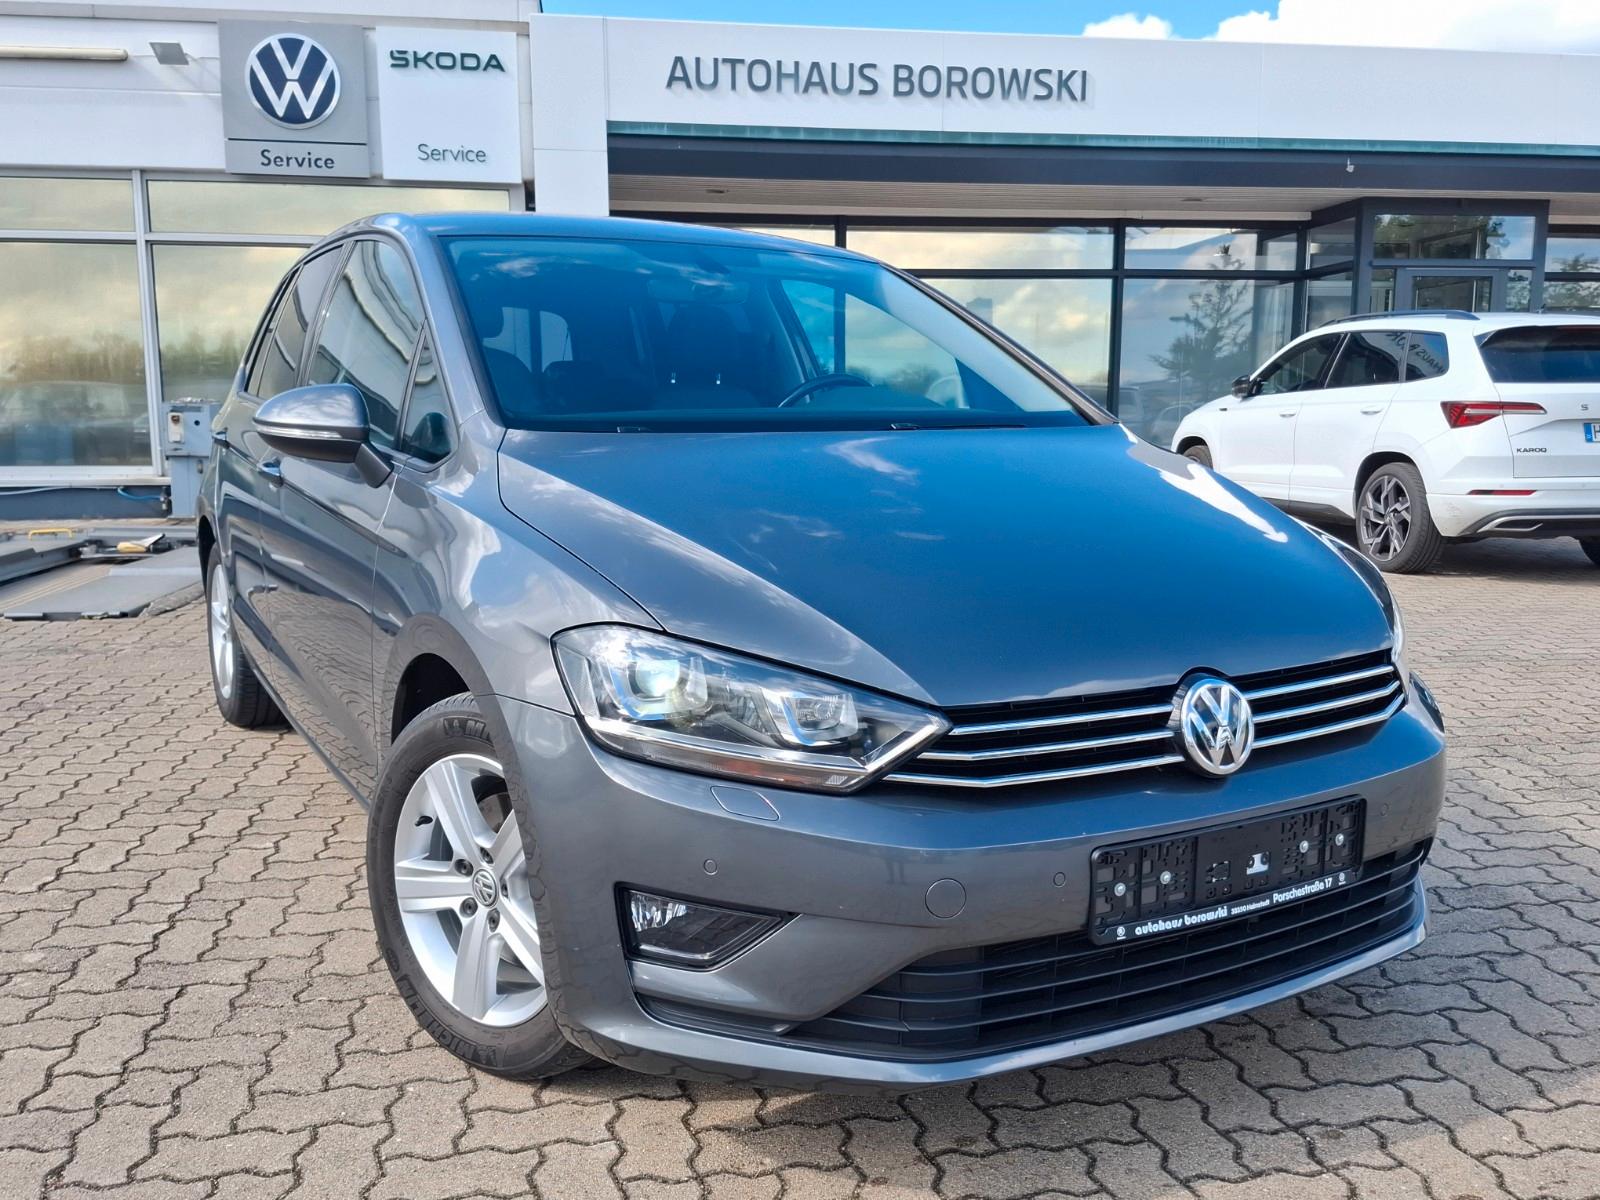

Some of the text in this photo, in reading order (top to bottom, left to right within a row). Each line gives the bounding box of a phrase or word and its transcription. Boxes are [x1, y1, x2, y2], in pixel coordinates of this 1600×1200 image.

[665, 55, 1088, 102] AUTOHAUS BOROWSKI
[260, 149, 335, 169] Service
[417, 143, 487, 163] Service
[1135, 919, 1183, 935] autohaus
[1184, 906, 1228, 925] borowski
[1272, 880, 1325, 904] Porschestraße
